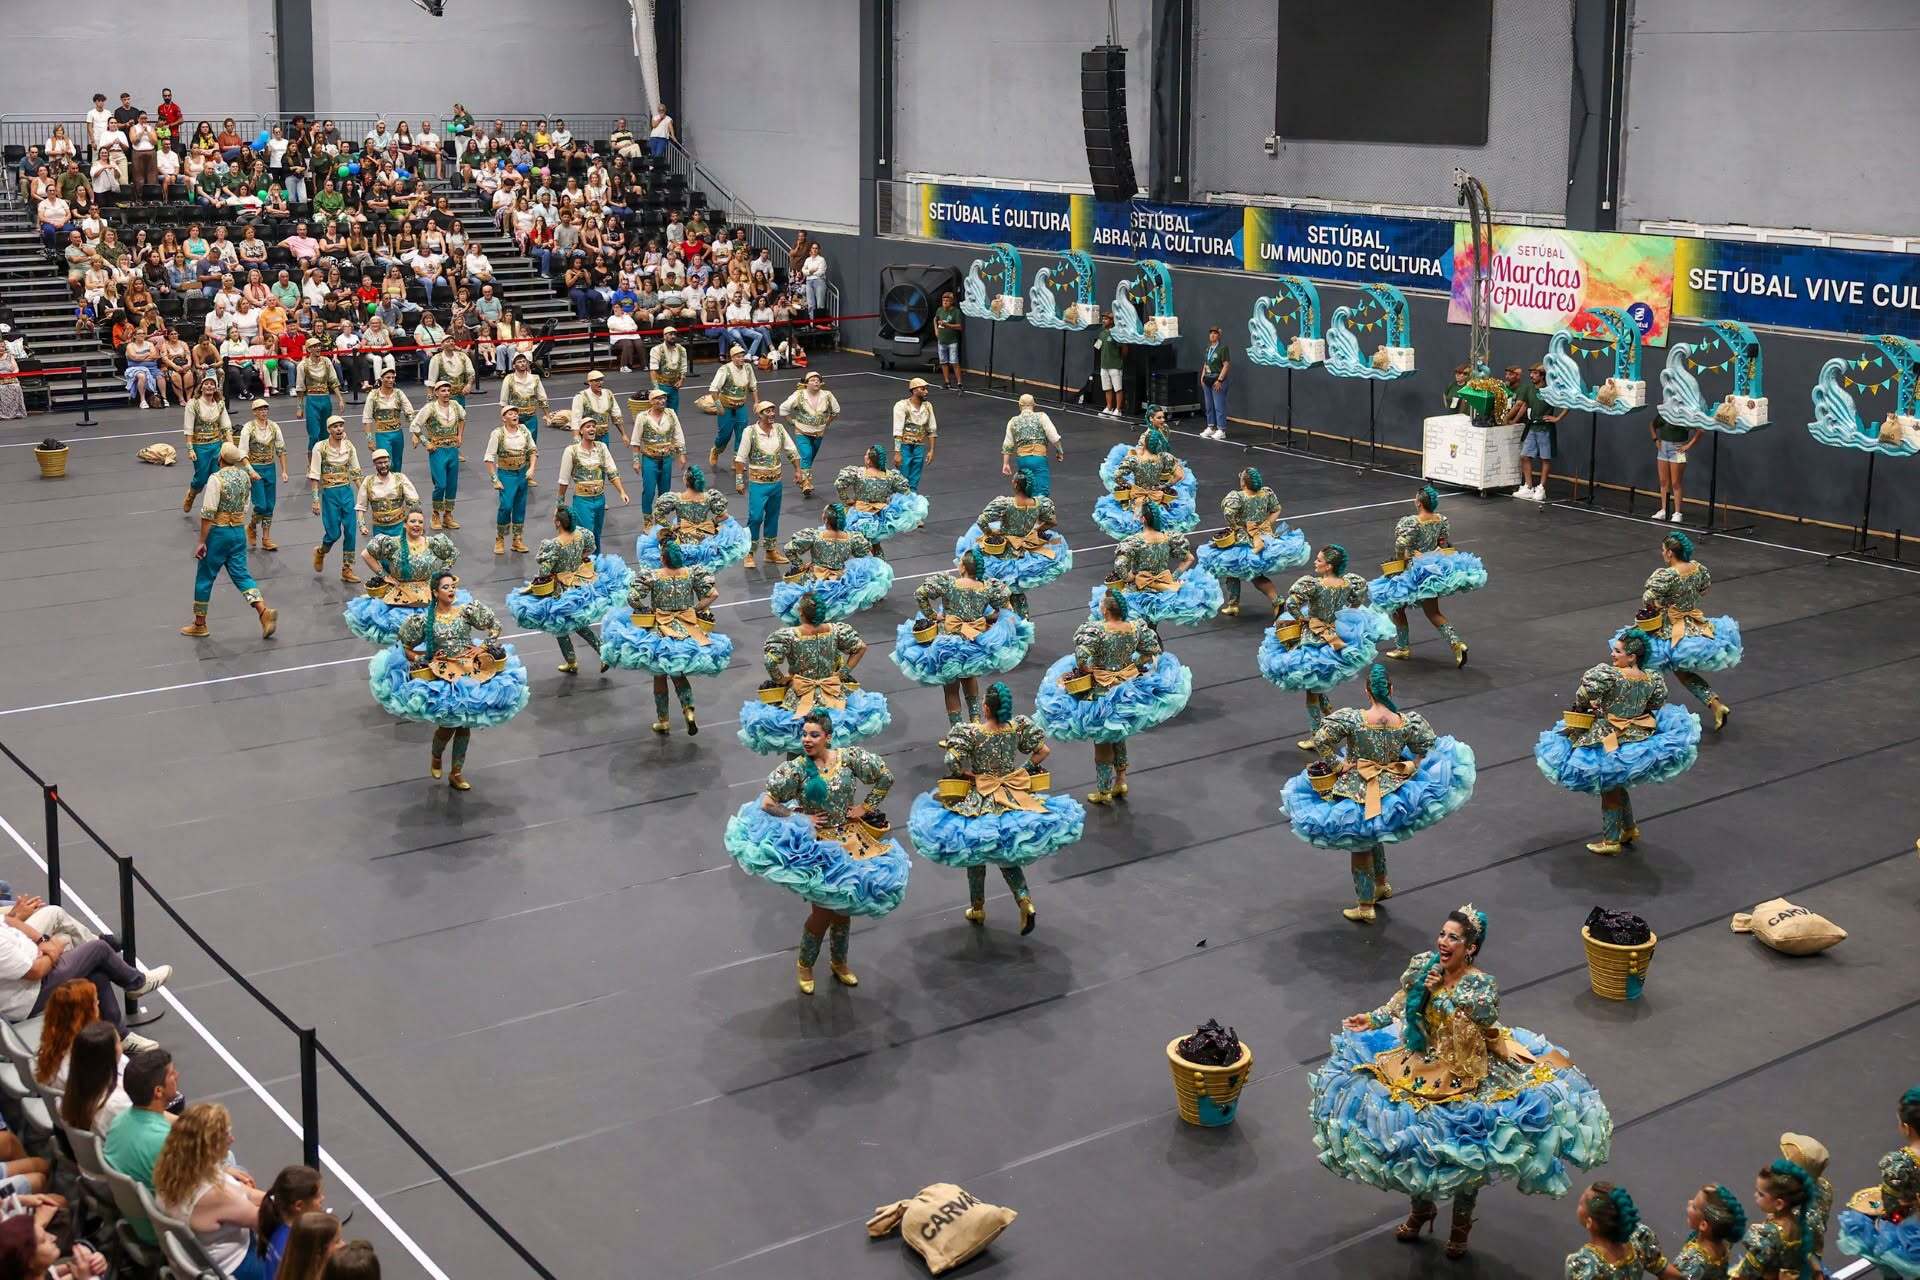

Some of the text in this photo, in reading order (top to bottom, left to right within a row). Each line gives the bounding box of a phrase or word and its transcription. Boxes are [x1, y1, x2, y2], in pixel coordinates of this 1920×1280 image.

[929, 200, 1071, 232] SETÚBAL É CULTURA
[1130, 210, 1194, 234] SETÚBAL
[1093, 228, 1235, 257] ABRAÇA A CULTURA
[1307, 224, 1390, 254] SETÚBAL,
[1517, 244, 1565, 259] SETÚBAL
[1260, 243, 1443, 277] UM MUNDO DE CULTURA
[1493, 255, 1581, 289] Marchas
[1480, 278, 1576, 313] Populares
[1688, 267, 1920, 310] SETÚBAL VIVE CUL
